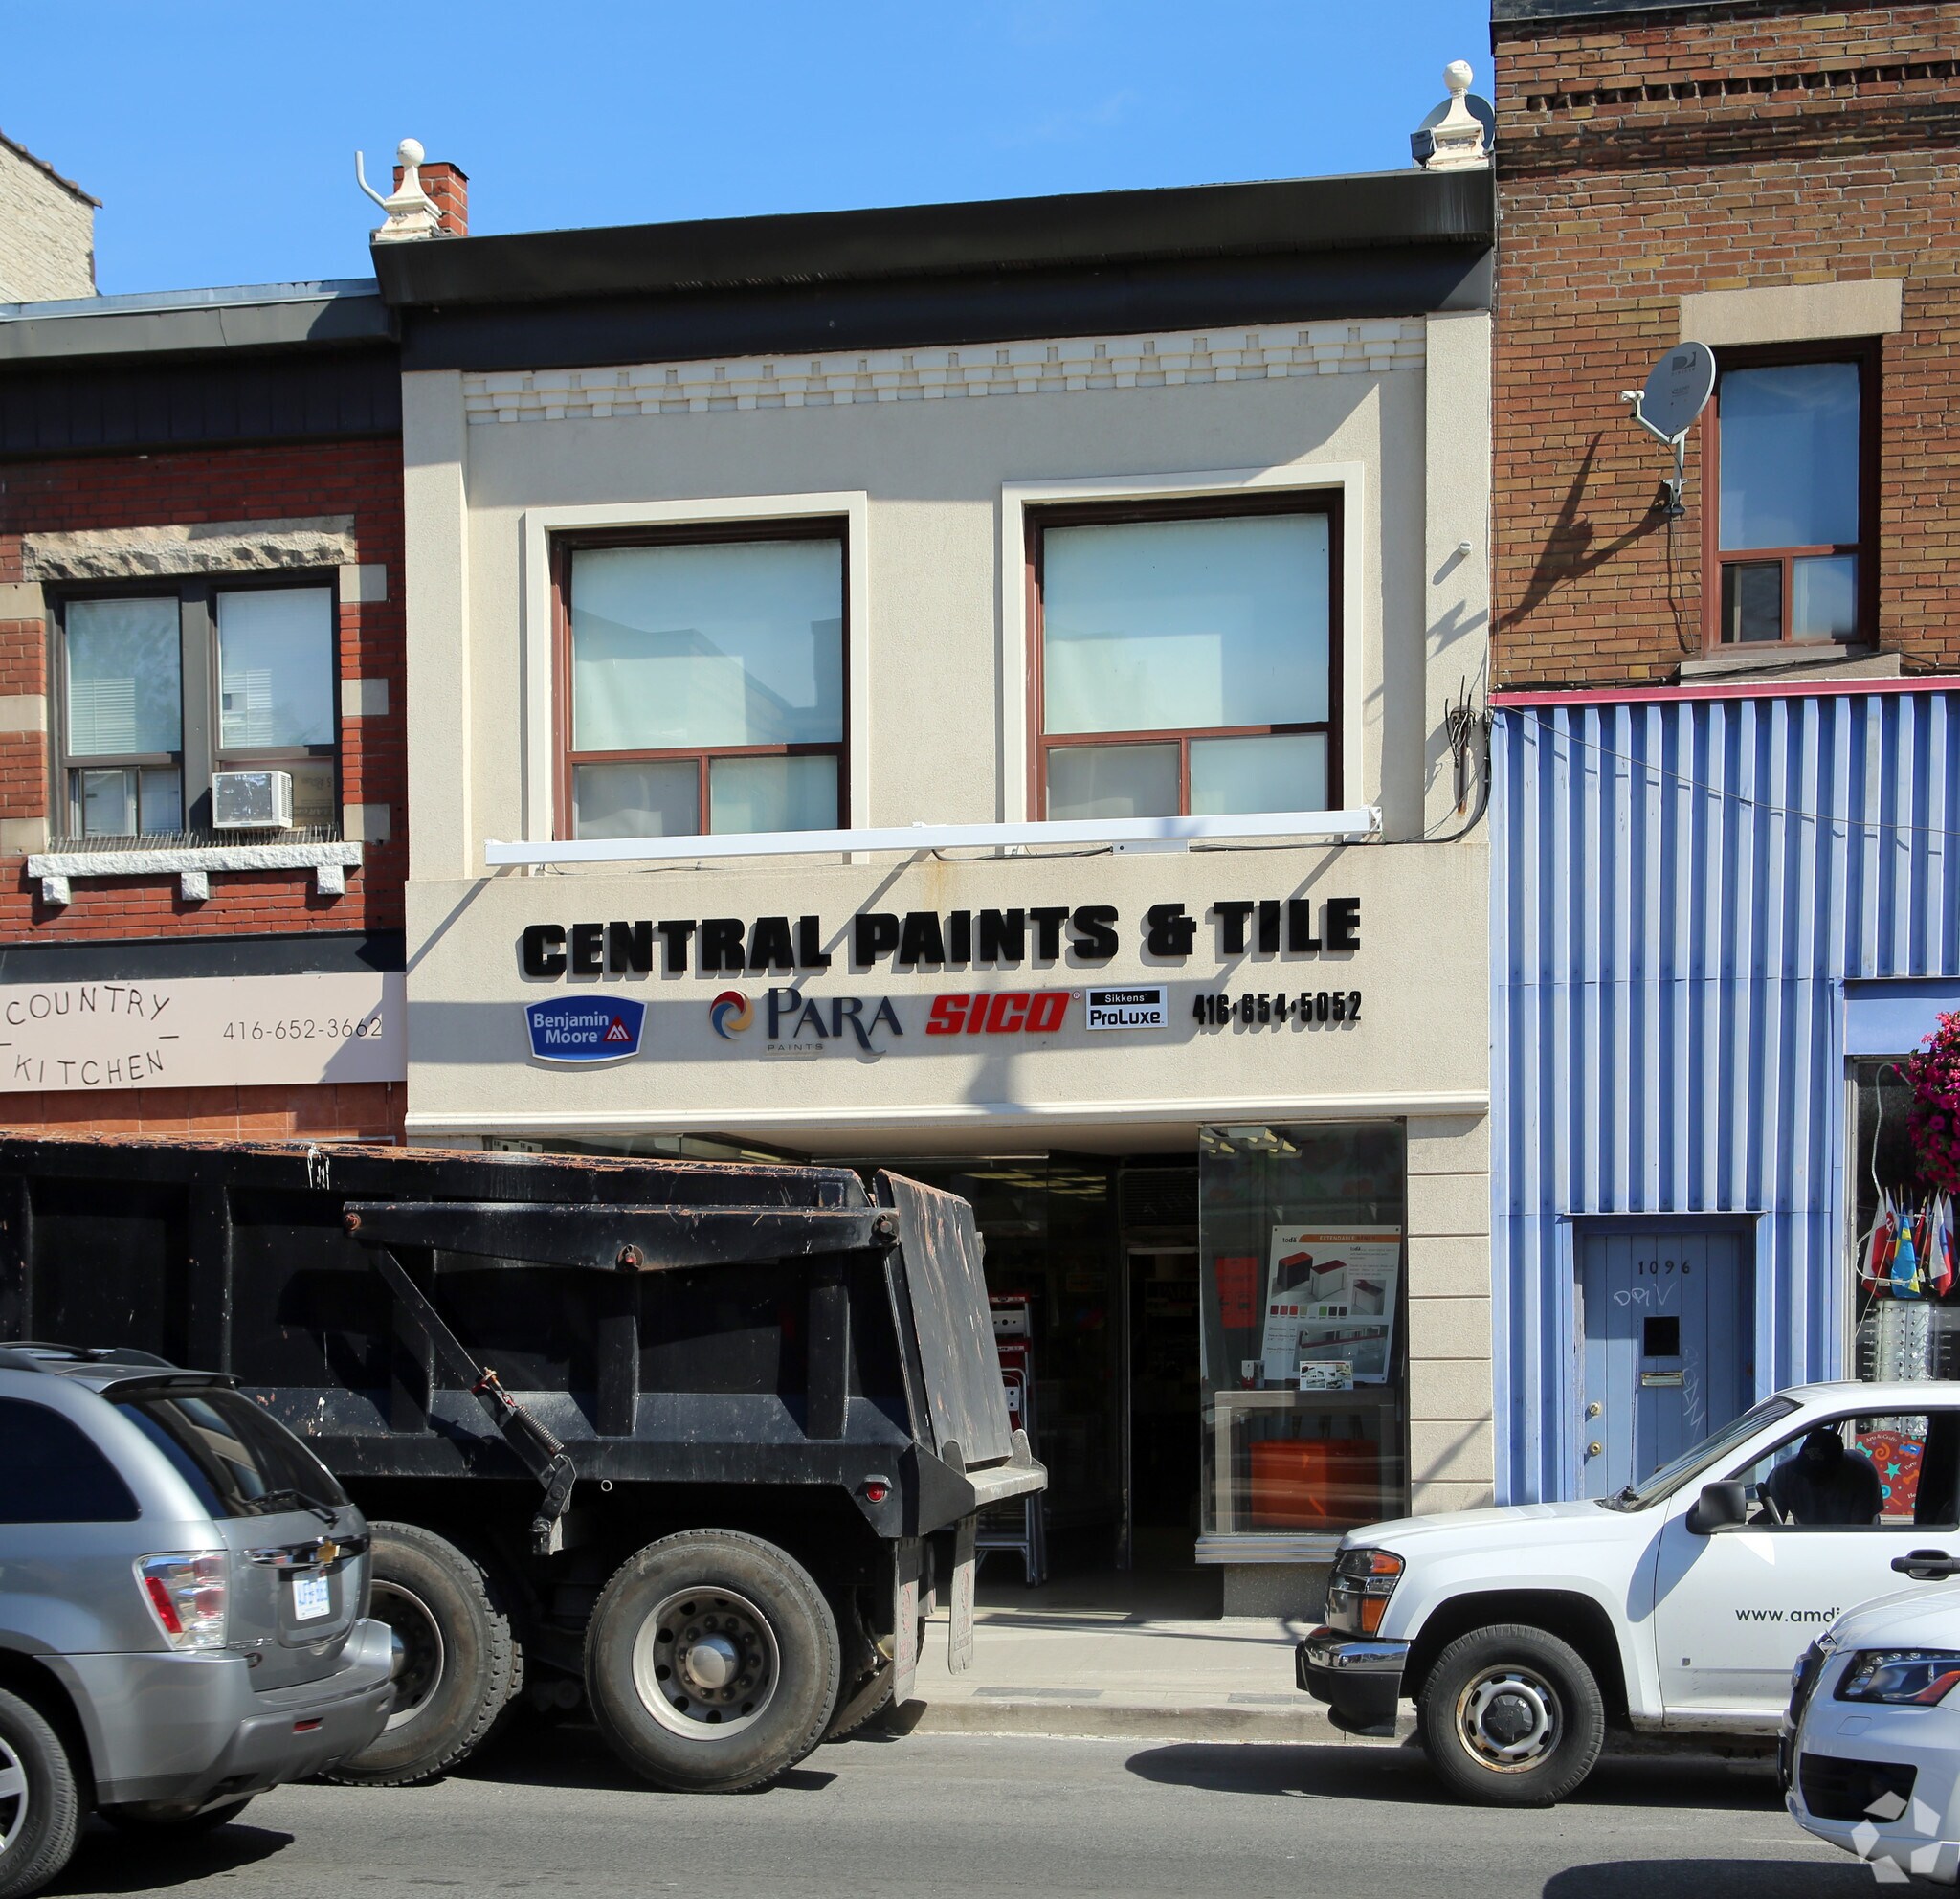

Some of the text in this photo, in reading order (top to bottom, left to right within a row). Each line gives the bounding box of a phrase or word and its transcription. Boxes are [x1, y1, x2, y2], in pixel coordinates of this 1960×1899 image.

[523, 897, 1361, 976] CENTRAL PAINTS & TILE
[6, 985, 170, 1025] COUNTRY
[1104, 994, 1145, 1003] Sikkens
[533, 1011, 610, 1032] Benjamin
[768, 987, 903, 1054] PARA
[925, 991, 1071, 1035] SICO
[1090, 1009, 1161, 1026] ProLuxe
[223, 1017, 383, 1041] 416-652-3662
[546, 1029, 598, 1044] Moore
[768, 1042, 824, 1051] PAINTS
[14, 1049, 165, 1085] KITCHEN
[1638, 1260, 1690, 1275] 1096
